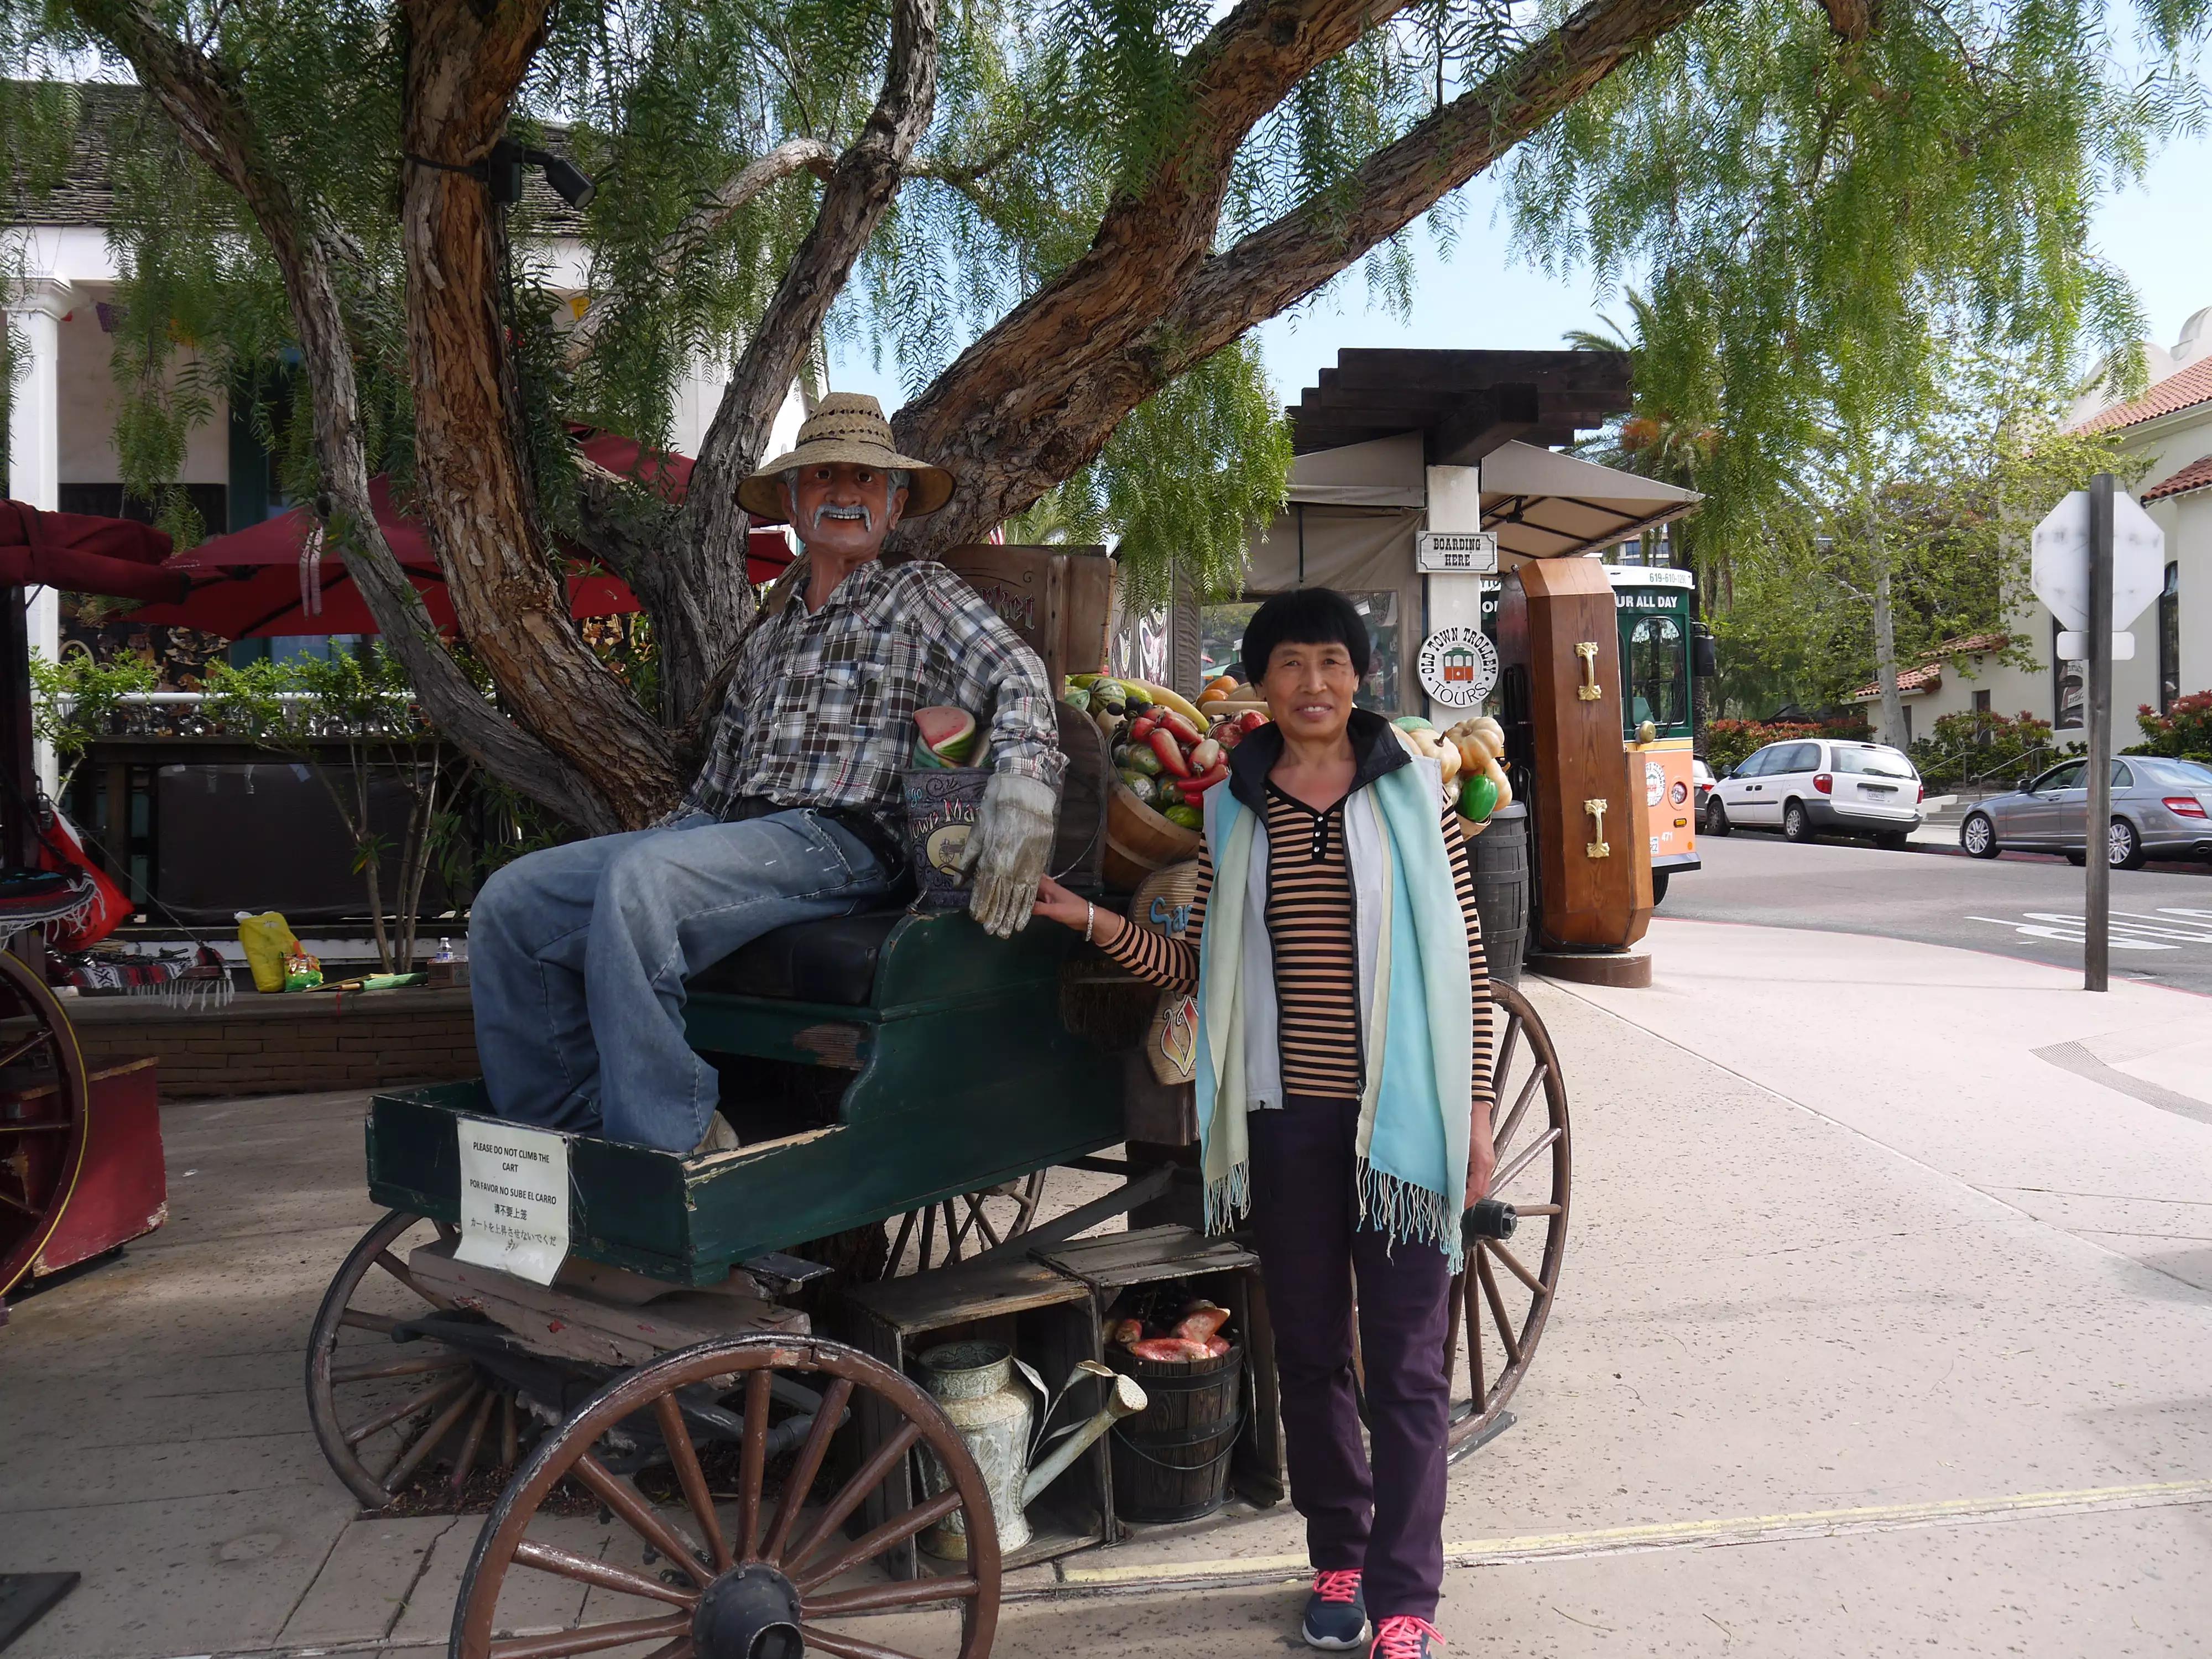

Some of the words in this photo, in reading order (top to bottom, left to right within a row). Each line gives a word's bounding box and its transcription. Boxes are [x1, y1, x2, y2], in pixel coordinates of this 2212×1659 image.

[1433, 538, 1481, 550] BOARDING
[1445, 554, 1470, 566] HERE
[1636, 596, 1655, 608] ALL
[1657, 596, 1678, 608] DAY
[1427, 627, 1458, 652] TOWN
[1463, 628, 1496, 674] TROLLEY
[1421, 652, 1435, 674] OLD
[1432, 680, 1488, 706] TOURS
[473, 1141, 493, 1153] PLEASE
[494, 1145, 503, 1155] DO
[504, 1147, 518, 1157] NOT
[519, 1150, 538, 1161] CLIMB
[539, 1153, 550, 1163] THE
[502, 1162, 519, 1172] CART
[470, 1179, 480, 1189] POR
[481, 1182, 499, 1194] FAVOR
[500, 1186, 509, 1196] NO
[510, 1188, 526, 1199] SUBE
[528, 1191, 534, 1201] EL
[535, 1193, 557, 1204] CARRO
